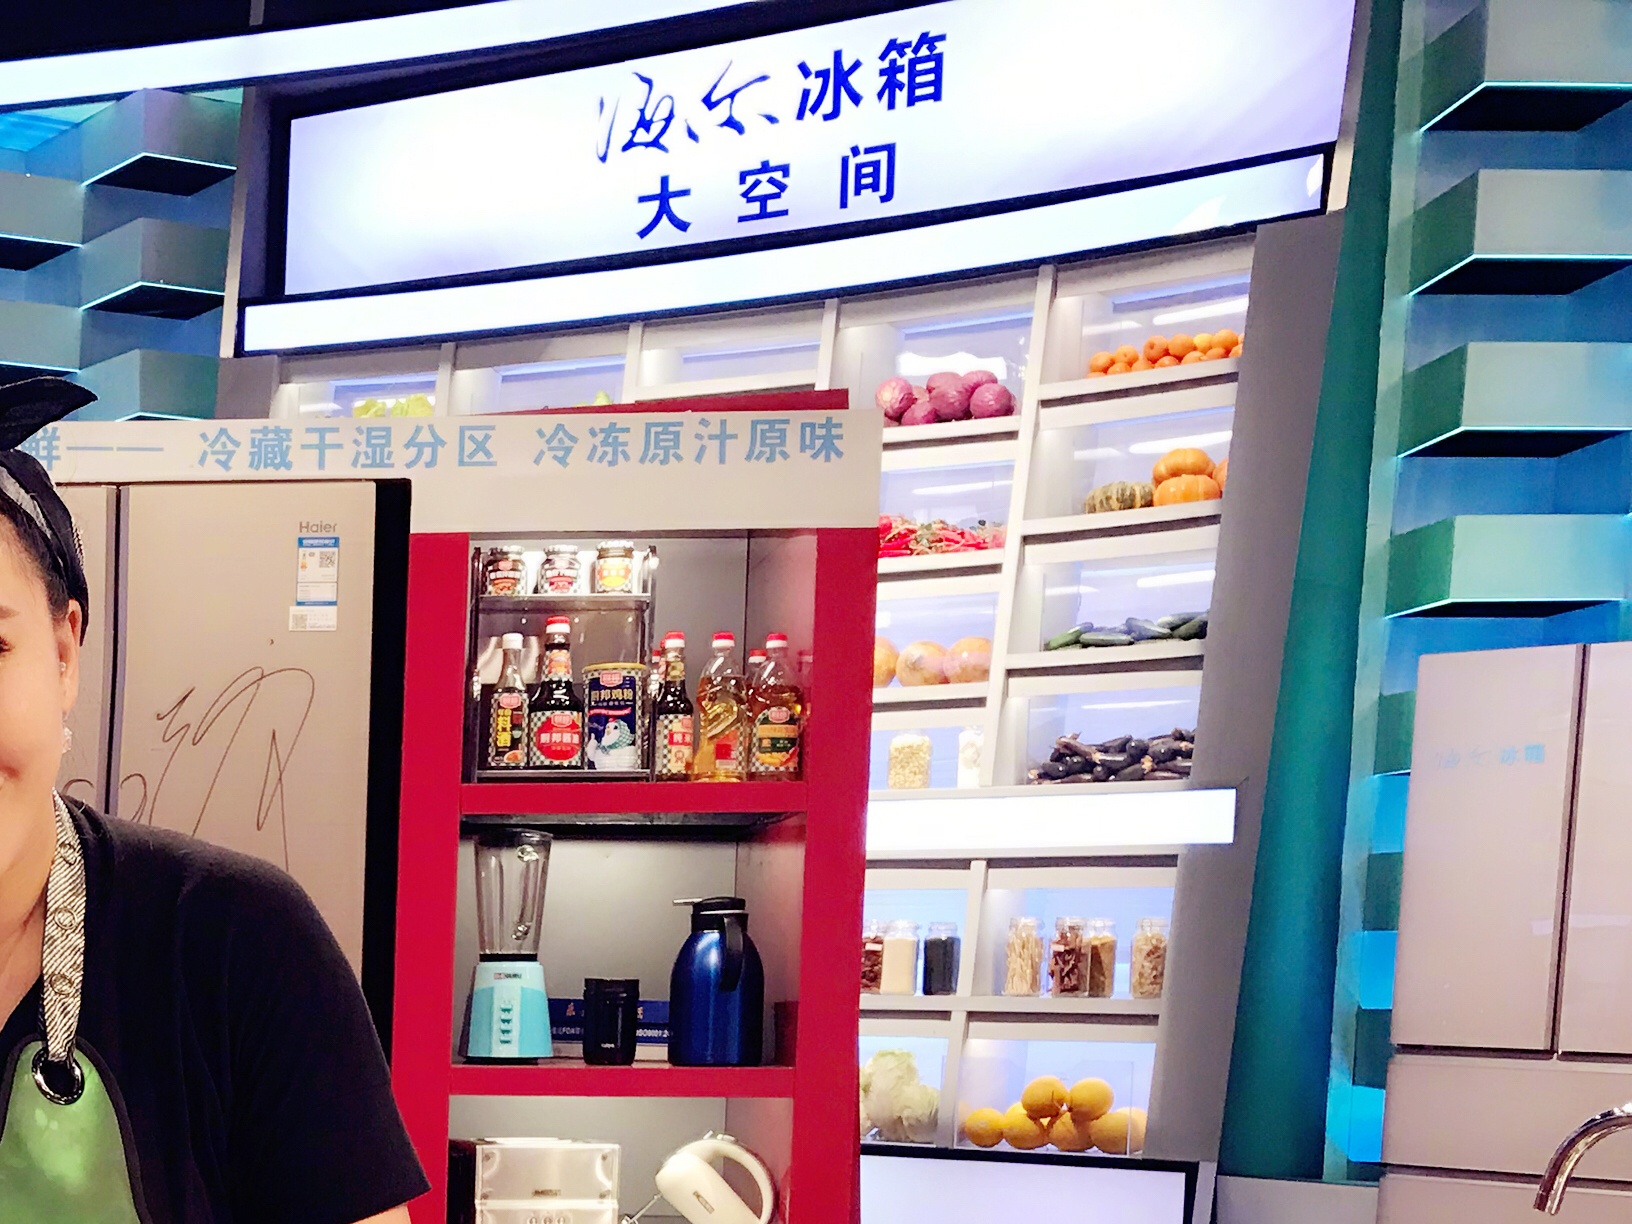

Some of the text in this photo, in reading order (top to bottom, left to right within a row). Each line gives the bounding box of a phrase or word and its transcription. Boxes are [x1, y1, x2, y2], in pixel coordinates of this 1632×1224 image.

[636, 142, 897, 239] 大空间
[198, 424, 497, 472] 冷藏干湿分区
[533, 416, 845, 469] 冷冻原汁原味
[299, 520, 338, 533] Haier
